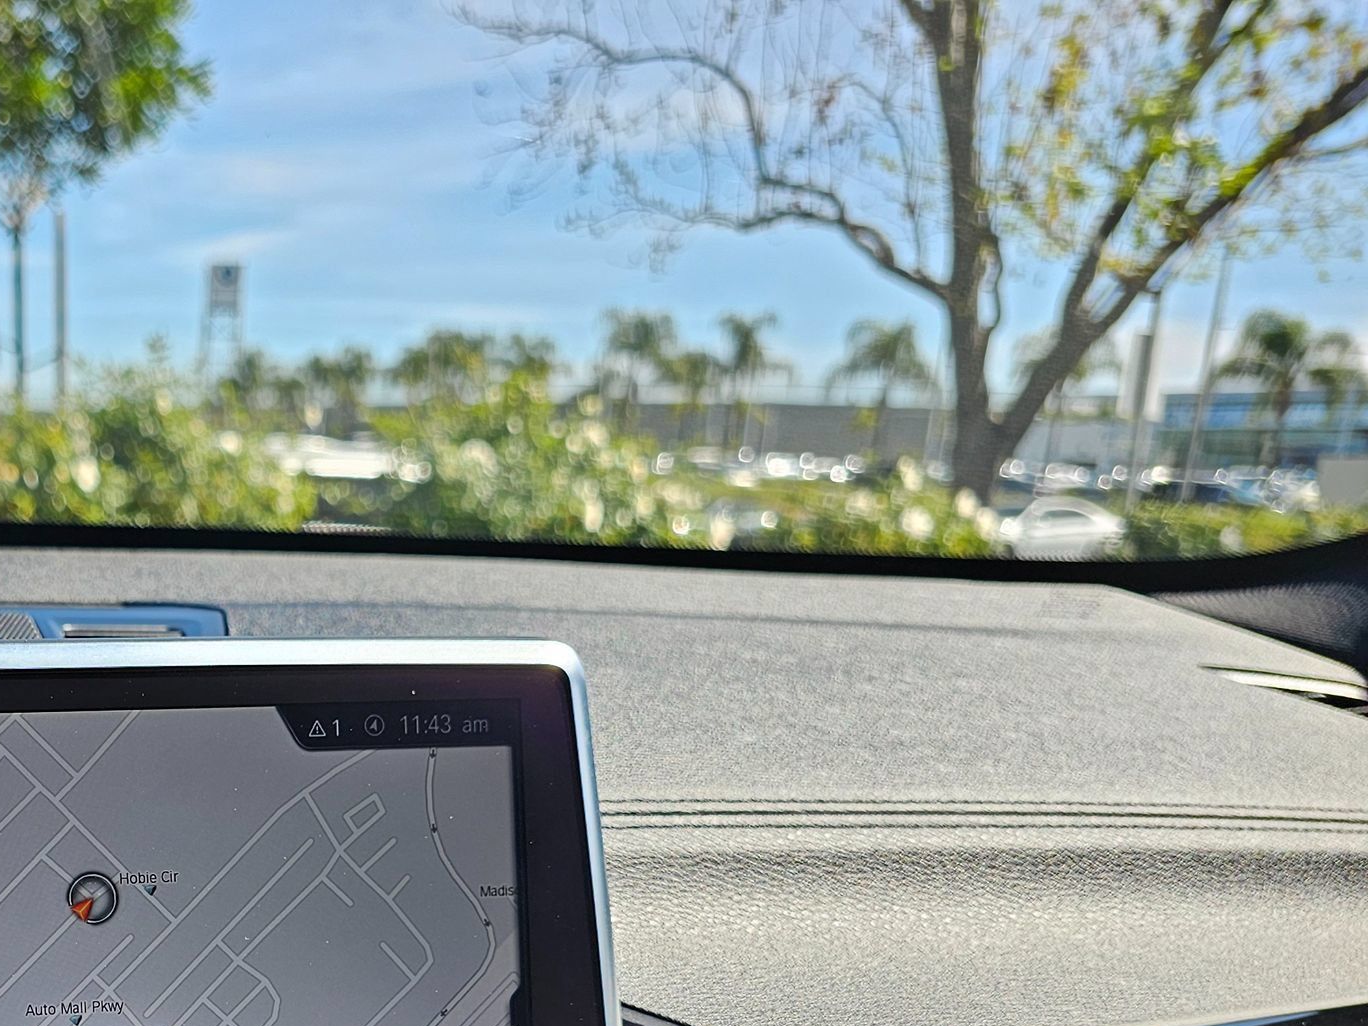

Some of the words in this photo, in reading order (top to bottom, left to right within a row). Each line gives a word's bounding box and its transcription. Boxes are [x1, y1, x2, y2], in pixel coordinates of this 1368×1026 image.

[332, 719, 340, 737] 1
[399, 714, 452, 735] 11:43
[461, 718, 489, 734] am
[119, 871, 157, 885] Hobie
[161, 870, 179, 883] Cir
[25, 1004, 56, 1017] Auto
[60, 1001, 87, 1015] Mall
[92, 1000, 124, 1015] Pkwy
